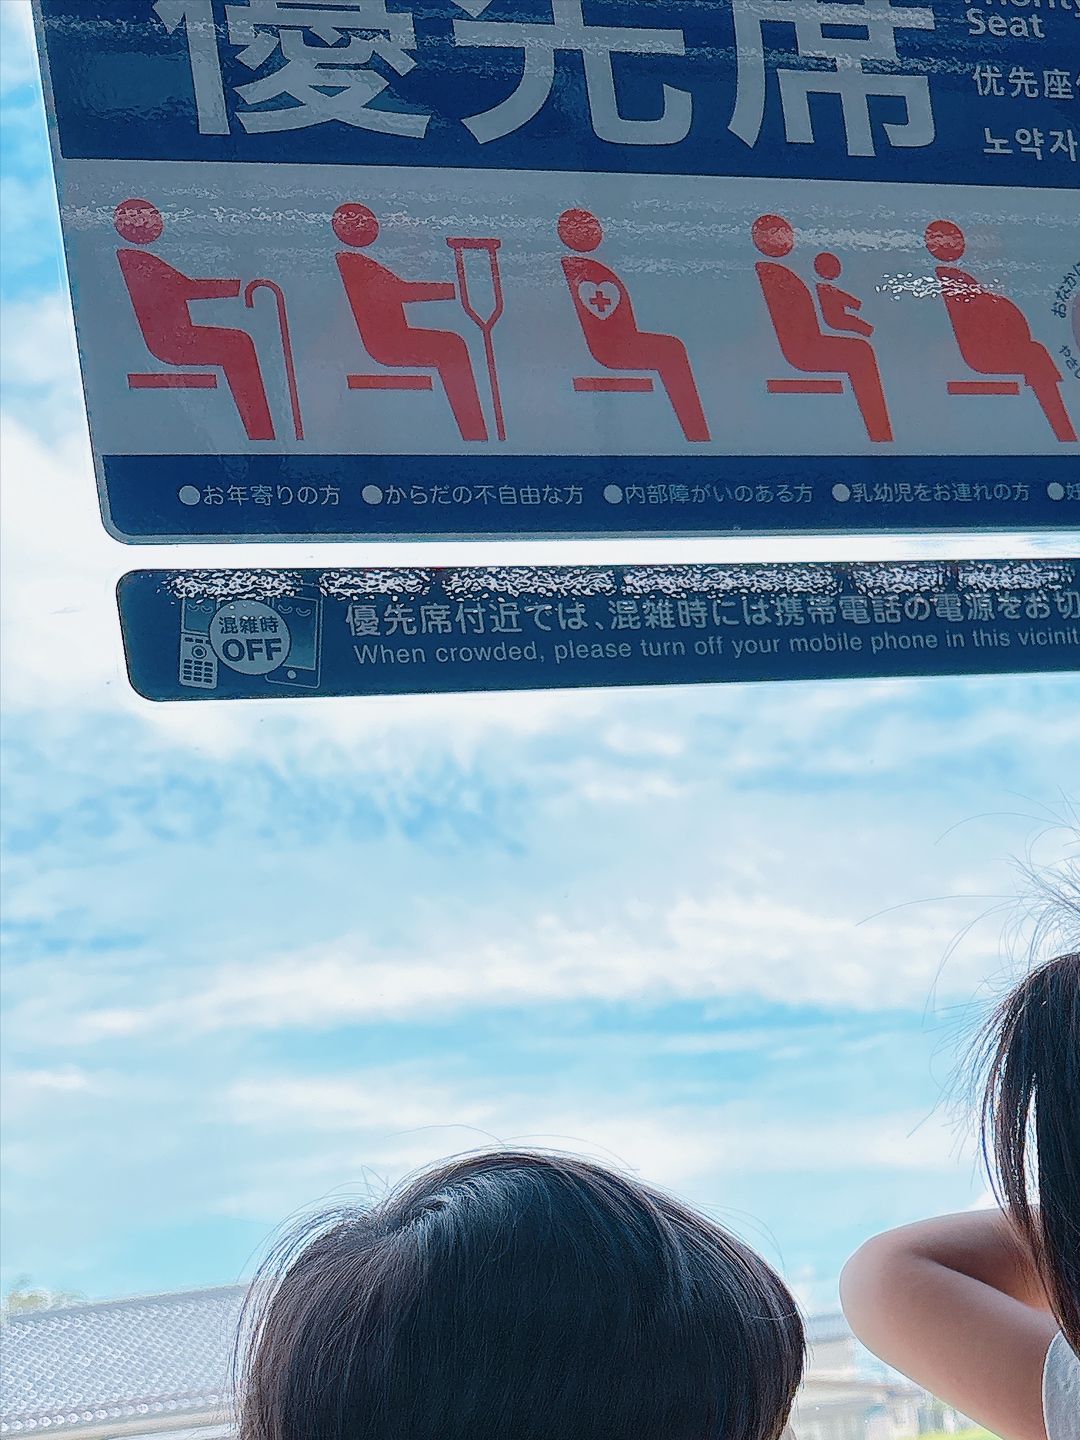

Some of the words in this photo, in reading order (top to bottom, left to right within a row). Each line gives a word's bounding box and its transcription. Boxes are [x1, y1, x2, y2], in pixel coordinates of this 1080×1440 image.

[966, 7, 1046, 39] Seat
[202, 484, 340, 507] お年寄りの方
[385, 484, 584, 506] からだの不自由な方
[218, 616, 279, 634] 混雑時
[222, 638, 282, 662] OFF
[353, 643, 426, 664] When
[435, 640, 546, 663] crowded,
[554, 639, 632, 664] please
[641, 637, 686, 656] turn
[694, 635, 724, 655] off
[731, 637, 780, 659] your
[789, 632, 863, 653] mobile
[871, 630, 938, 654] phone
[946, 629, 965, 648] in
[972, 628, 1011, 647] this
